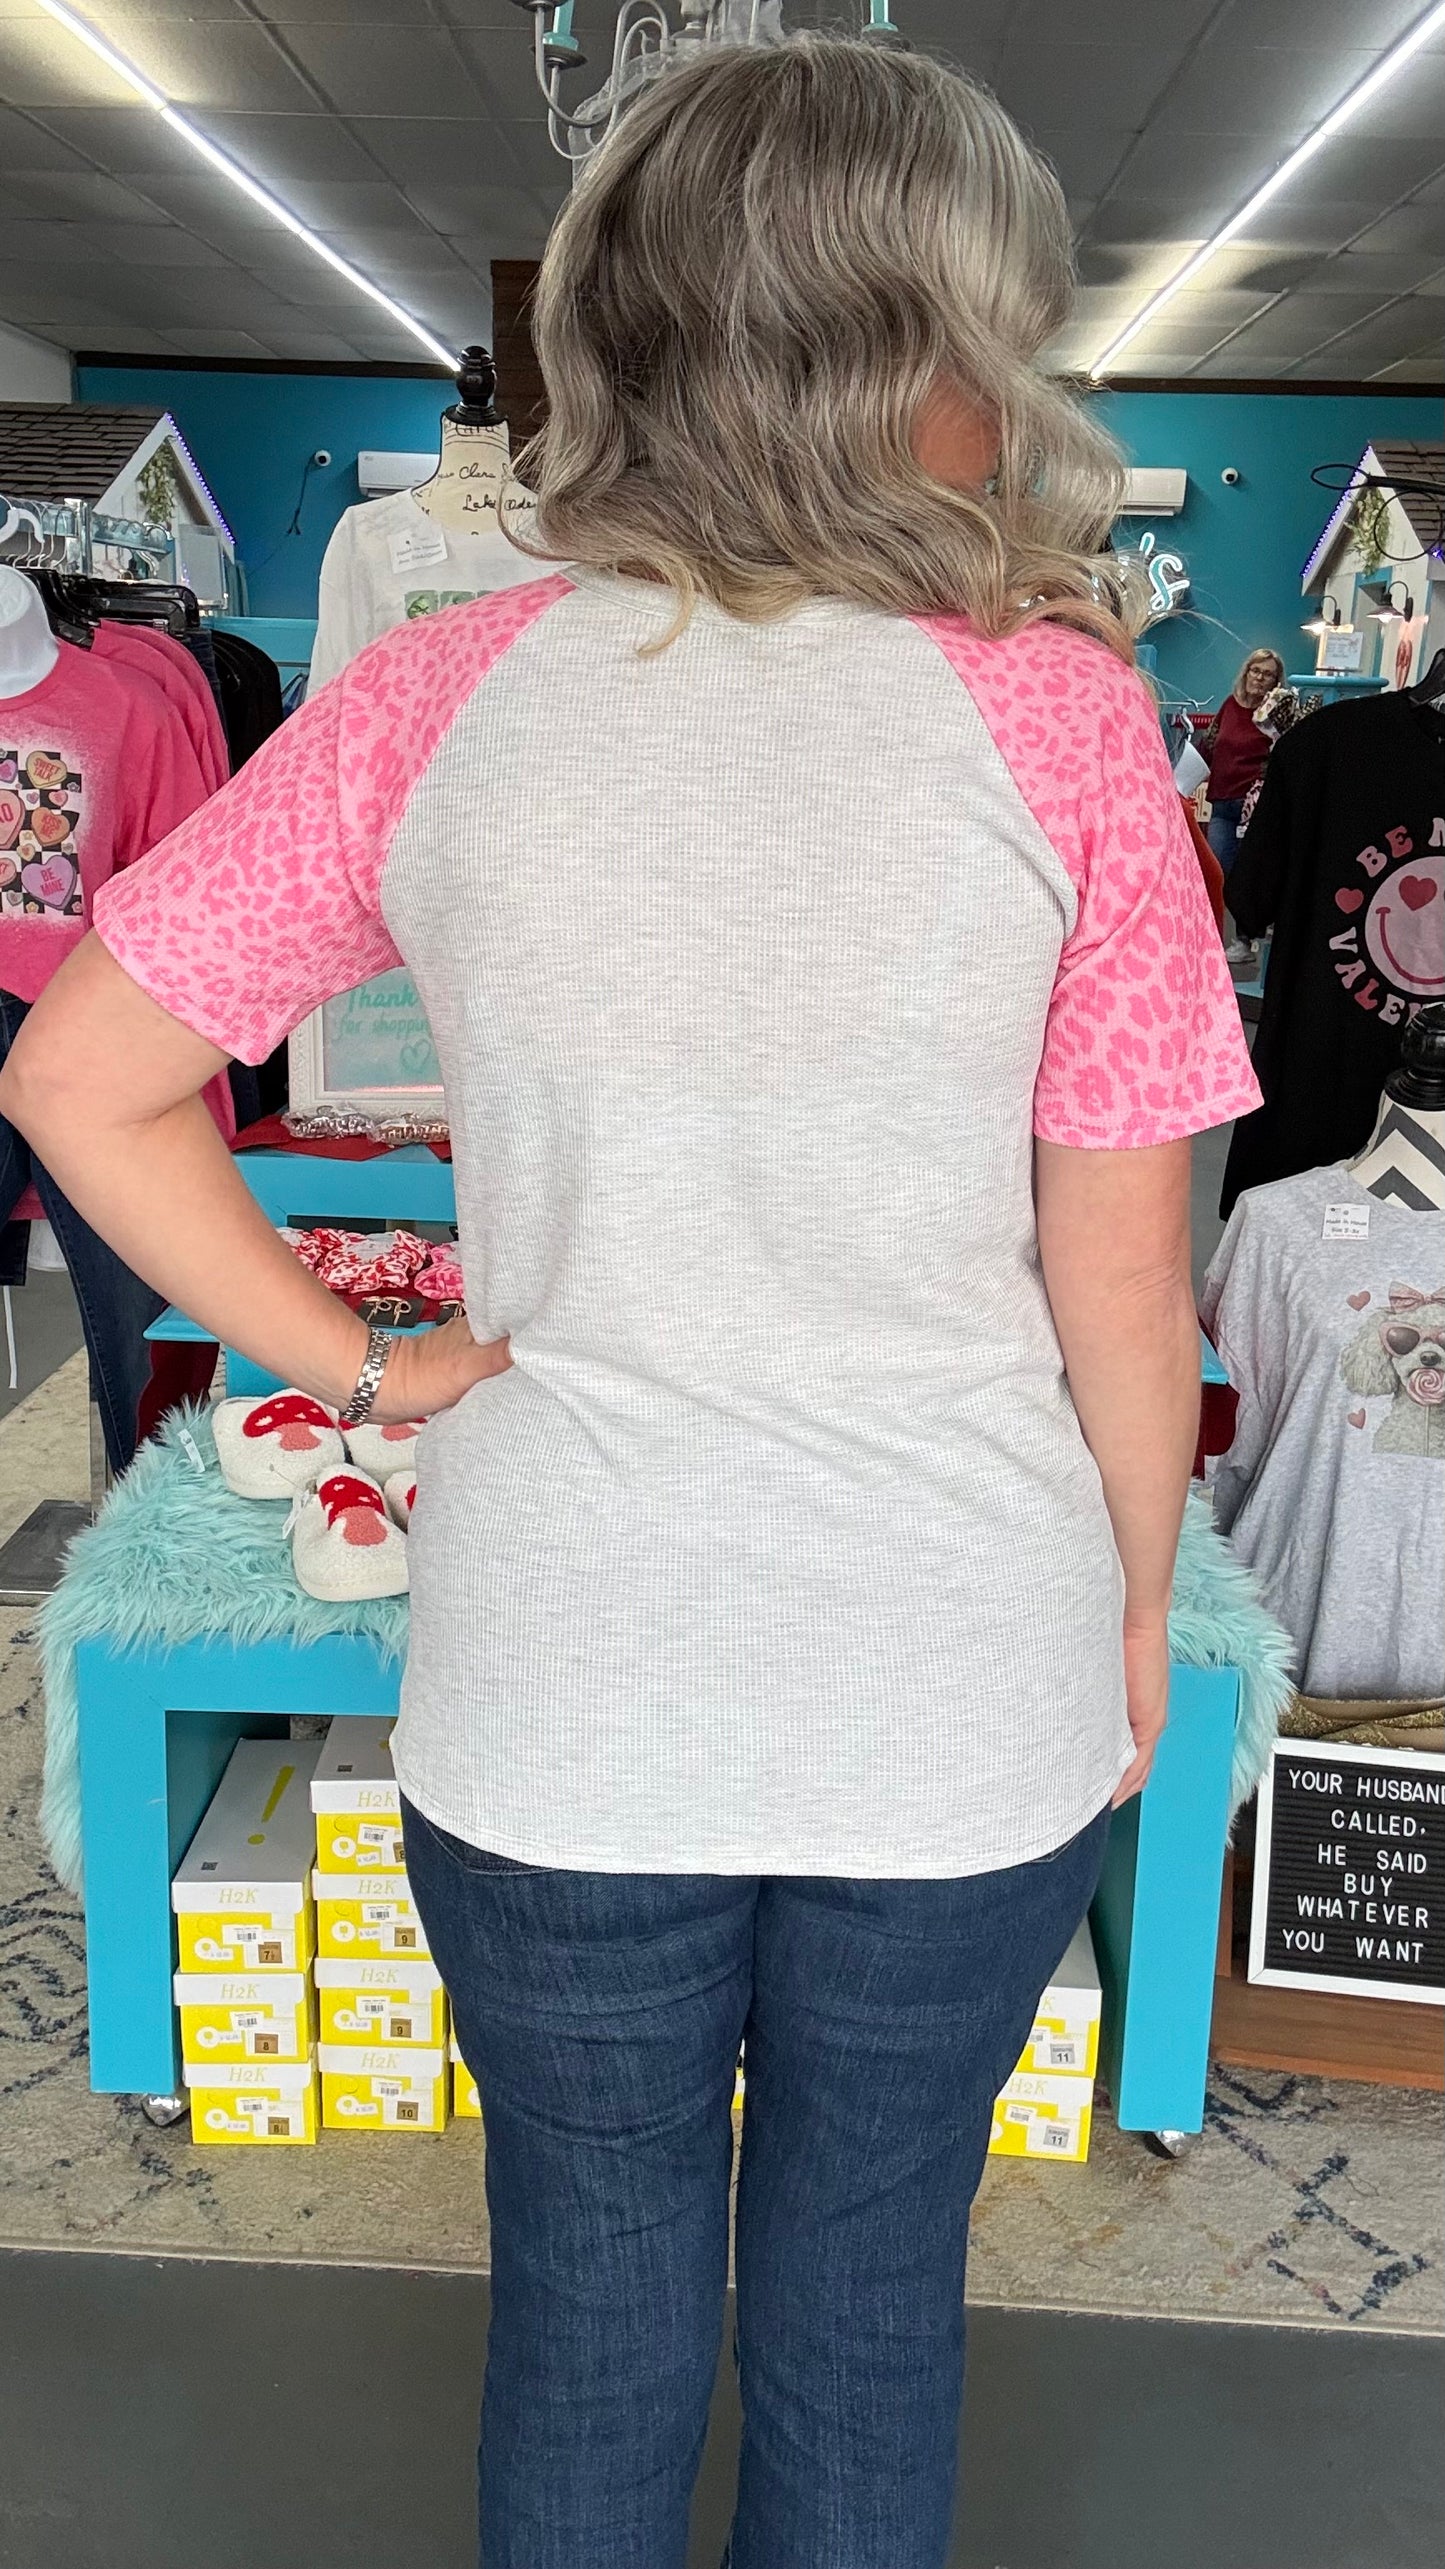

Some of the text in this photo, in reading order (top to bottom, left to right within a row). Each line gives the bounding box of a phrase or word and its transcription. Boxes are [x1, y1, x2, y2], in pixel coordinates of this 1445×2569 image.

[1356, 825, 1413, 878] BE
[41, 867, 55, 882] BE
[1289, 1768, 1343, 1795] YOUR
[357, 1791, 397, 1807] H2K
[1317, 1843, 1427, 1874] HE SAID
[358, 1880, 398, 1895] H2K
[1343, 1873, 1393, 1897] BUY
[219, 1888, 258, 1904] H2K
[1297, 1895, 1429, 1929] WHATEVER
[401, 1934, 408, 1945] 9
[1282, 1929, 1424, 1964] YOU WANT
[361, 1968, 400, 1983] H2K
[220, 1983, 260, 1999] H2K
[396, 2026, 403, 2035] 9
[262, 2042, 269, 2051] 8
[361, 2052, 400, 2068] H2K
[1057, 2052, 1069, 2063] 11
[229, 2067, 268, 2082] H2K
[1009, 2078, 1048, 2095] H2K
[401, 2109, 413, 2118] 10
[1051, 2135, 1063, 2146] 11
